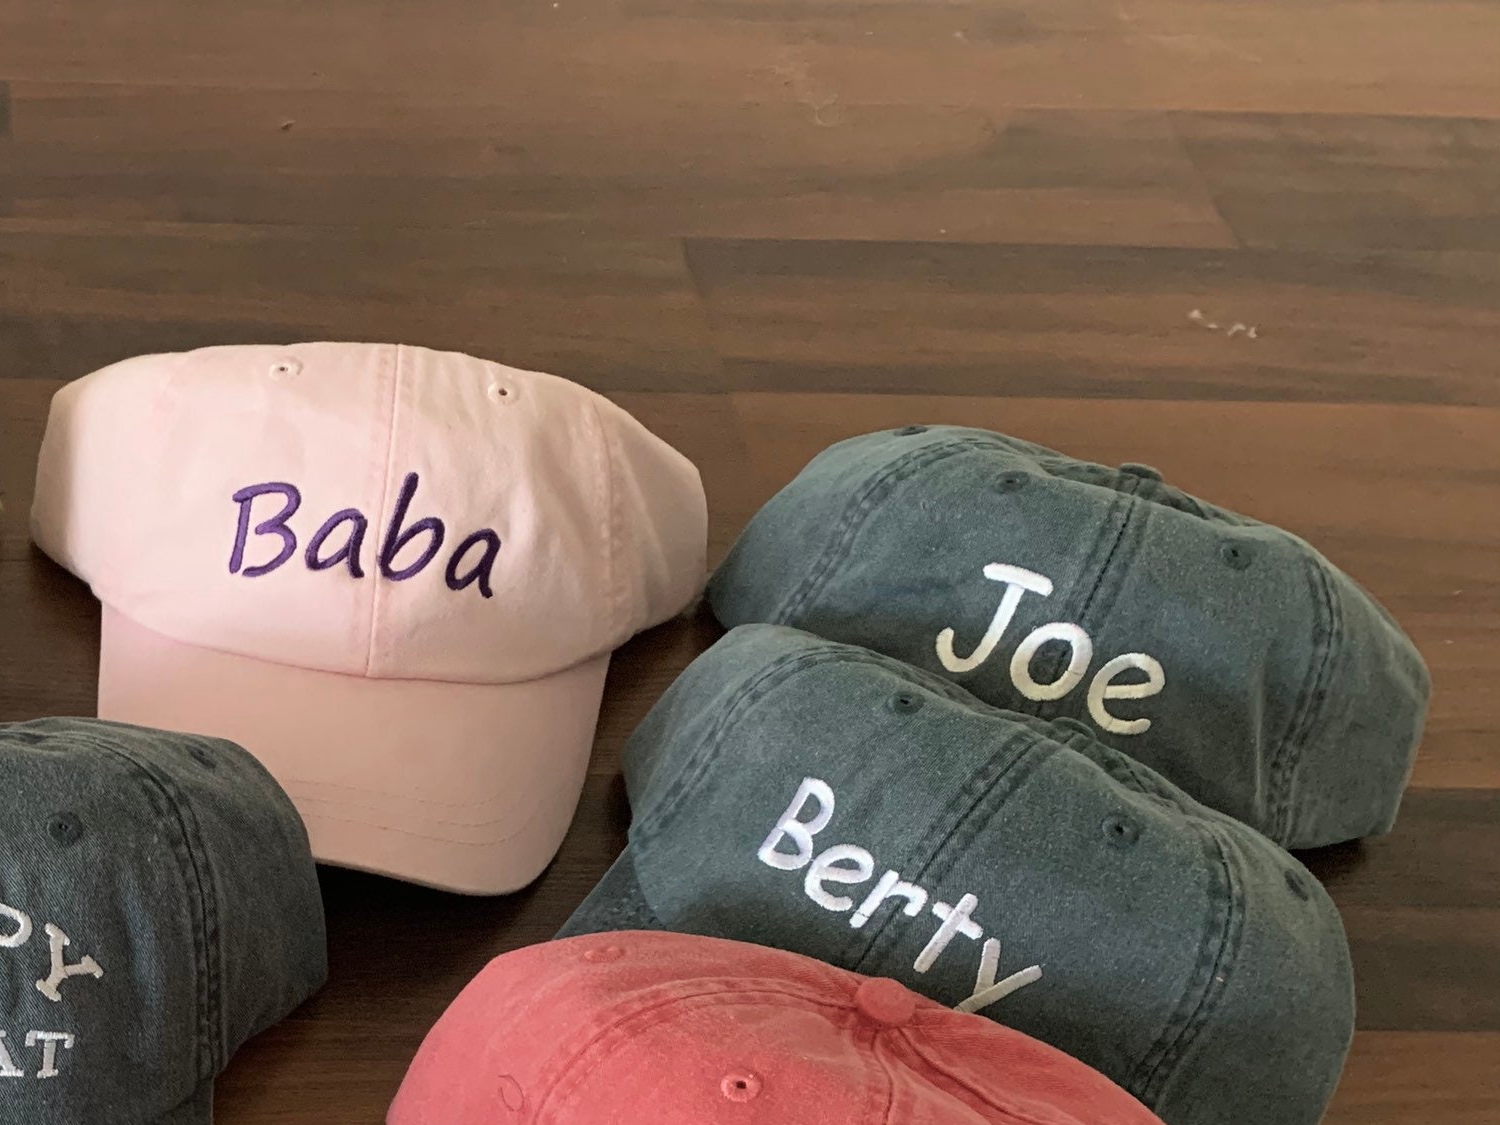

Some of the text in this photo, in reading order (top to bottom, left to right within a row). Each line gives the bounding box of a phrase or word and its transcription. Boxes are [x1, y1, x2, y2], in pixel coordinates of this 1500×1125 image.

[231, 473, 497, 598] Baba
[937, 562, 1165, 735] Joe
[757, 777, 1043, 1013] Berty
